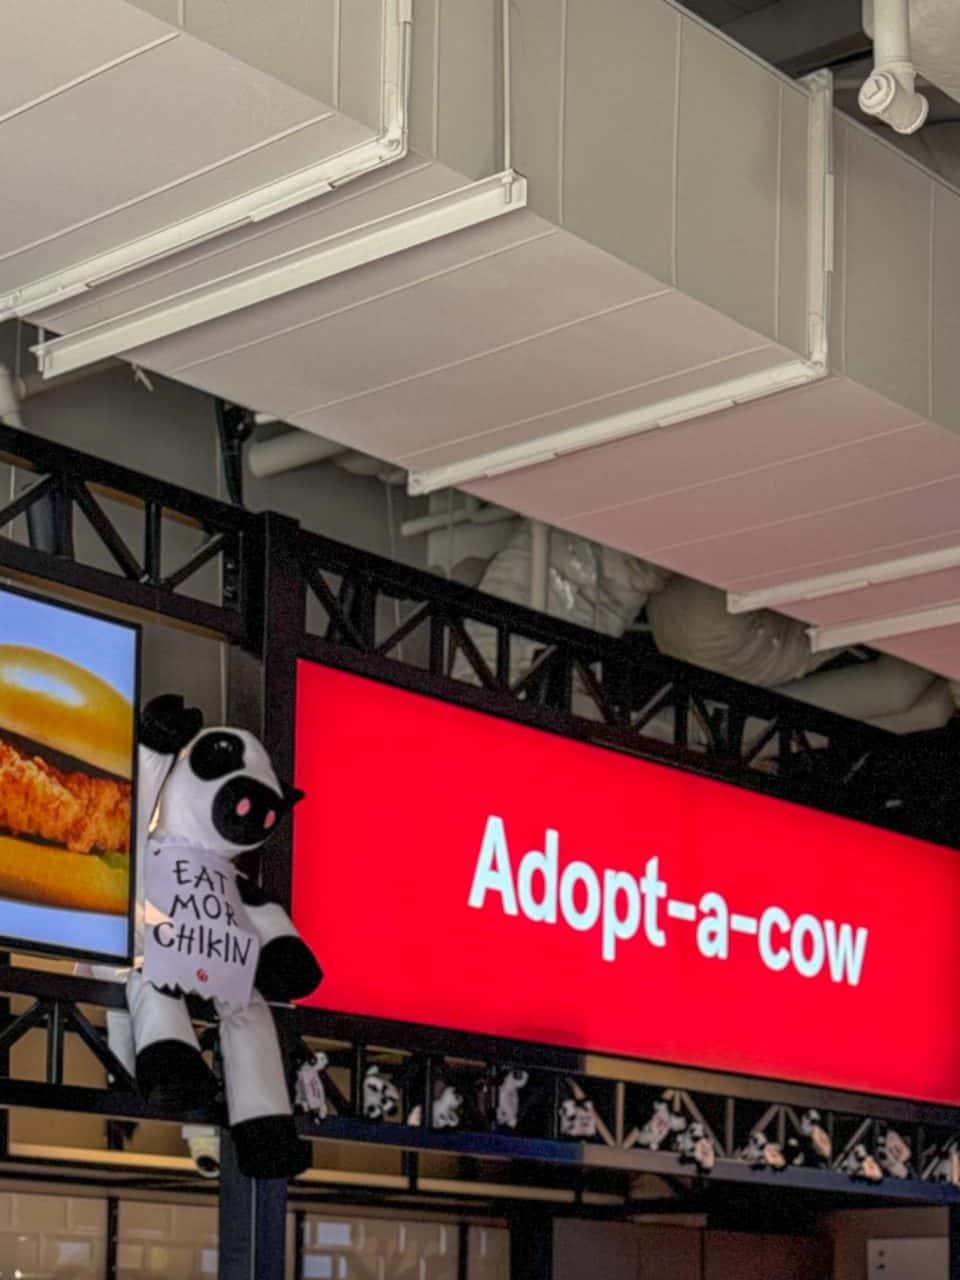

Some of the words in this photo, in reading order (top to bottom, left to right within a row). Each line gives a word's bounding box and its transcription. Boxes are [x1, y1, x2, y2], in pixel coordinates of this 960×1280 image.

[172, 860, 228, 895] EAT
[169, 894, 239, 927] MOR
[467, 814, 869, 987] Adopt-a-cow
